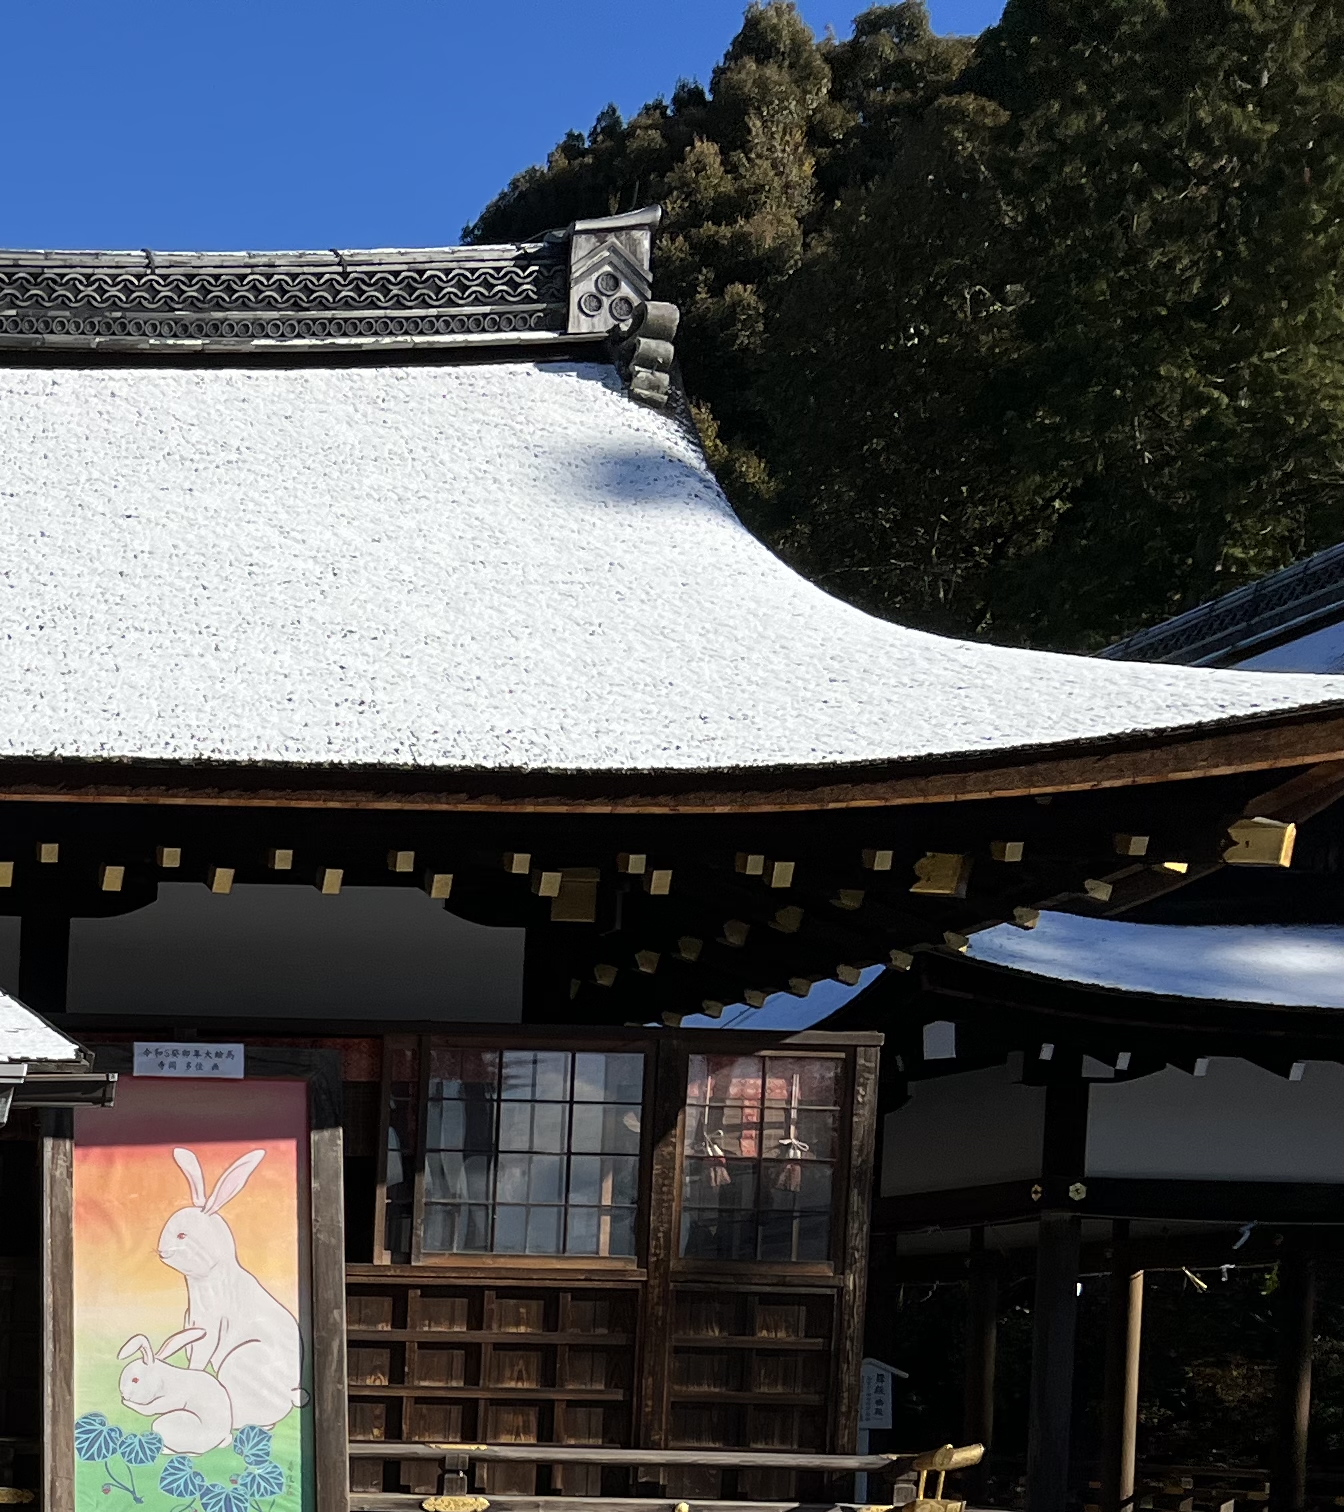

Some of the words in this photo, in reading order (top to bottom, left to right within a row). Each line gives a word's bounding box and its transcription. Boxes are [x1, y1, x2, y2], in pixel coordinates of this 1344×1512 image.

[142, 1048, 235, 1060] 令和5癸卯年大絵馬
